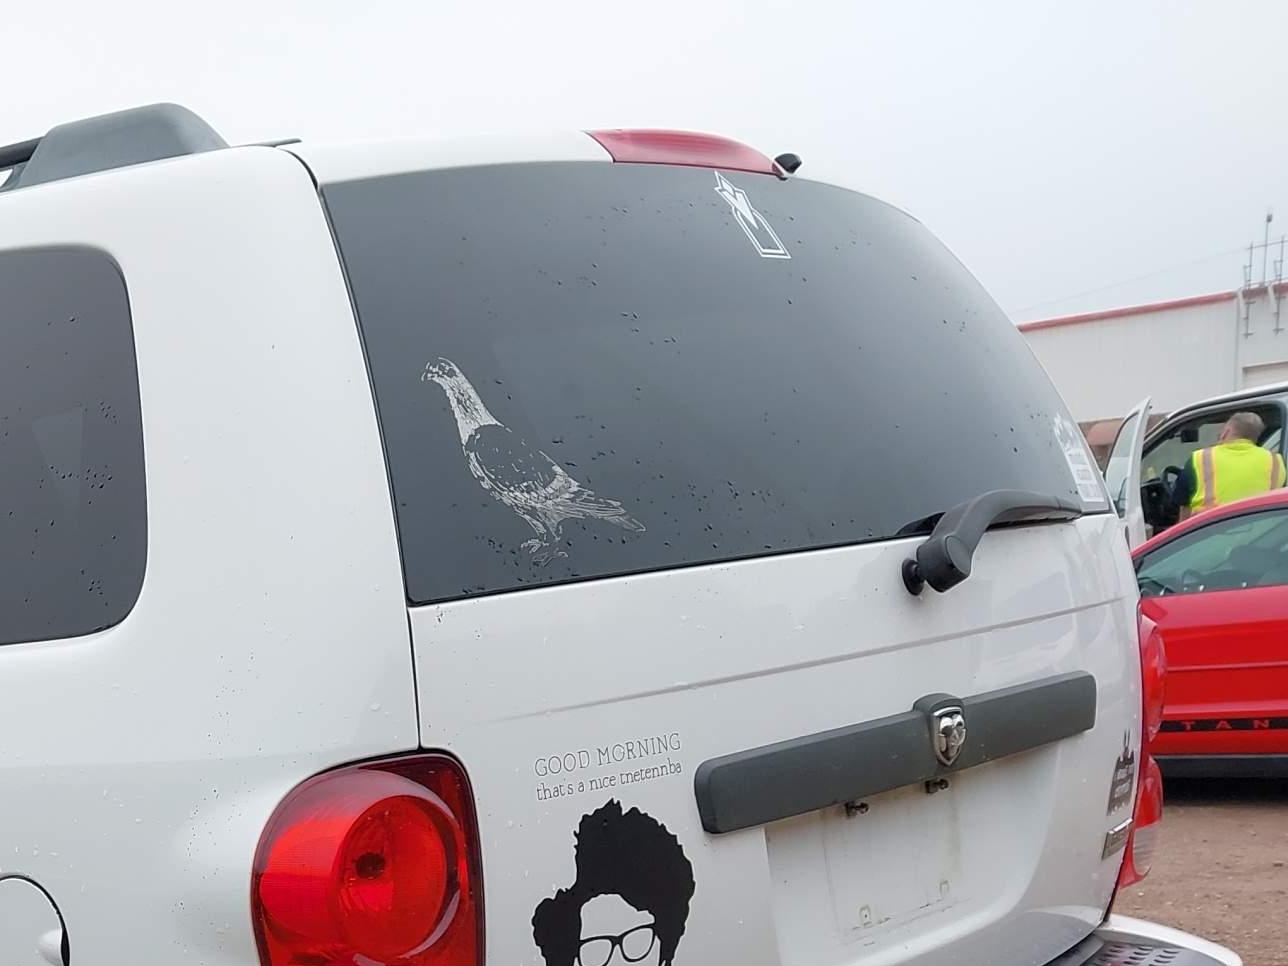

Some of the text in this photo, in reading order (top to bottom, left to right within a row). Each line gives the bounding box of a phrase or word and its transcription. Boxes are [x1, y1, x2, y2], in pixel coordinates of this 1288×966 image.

[534, 732, 681, 777] GOOD MORNING
[578, 781, 585, 792] a
[589, 775, 616, 791] nice
[619, 757, 682, 785] tnetennba
